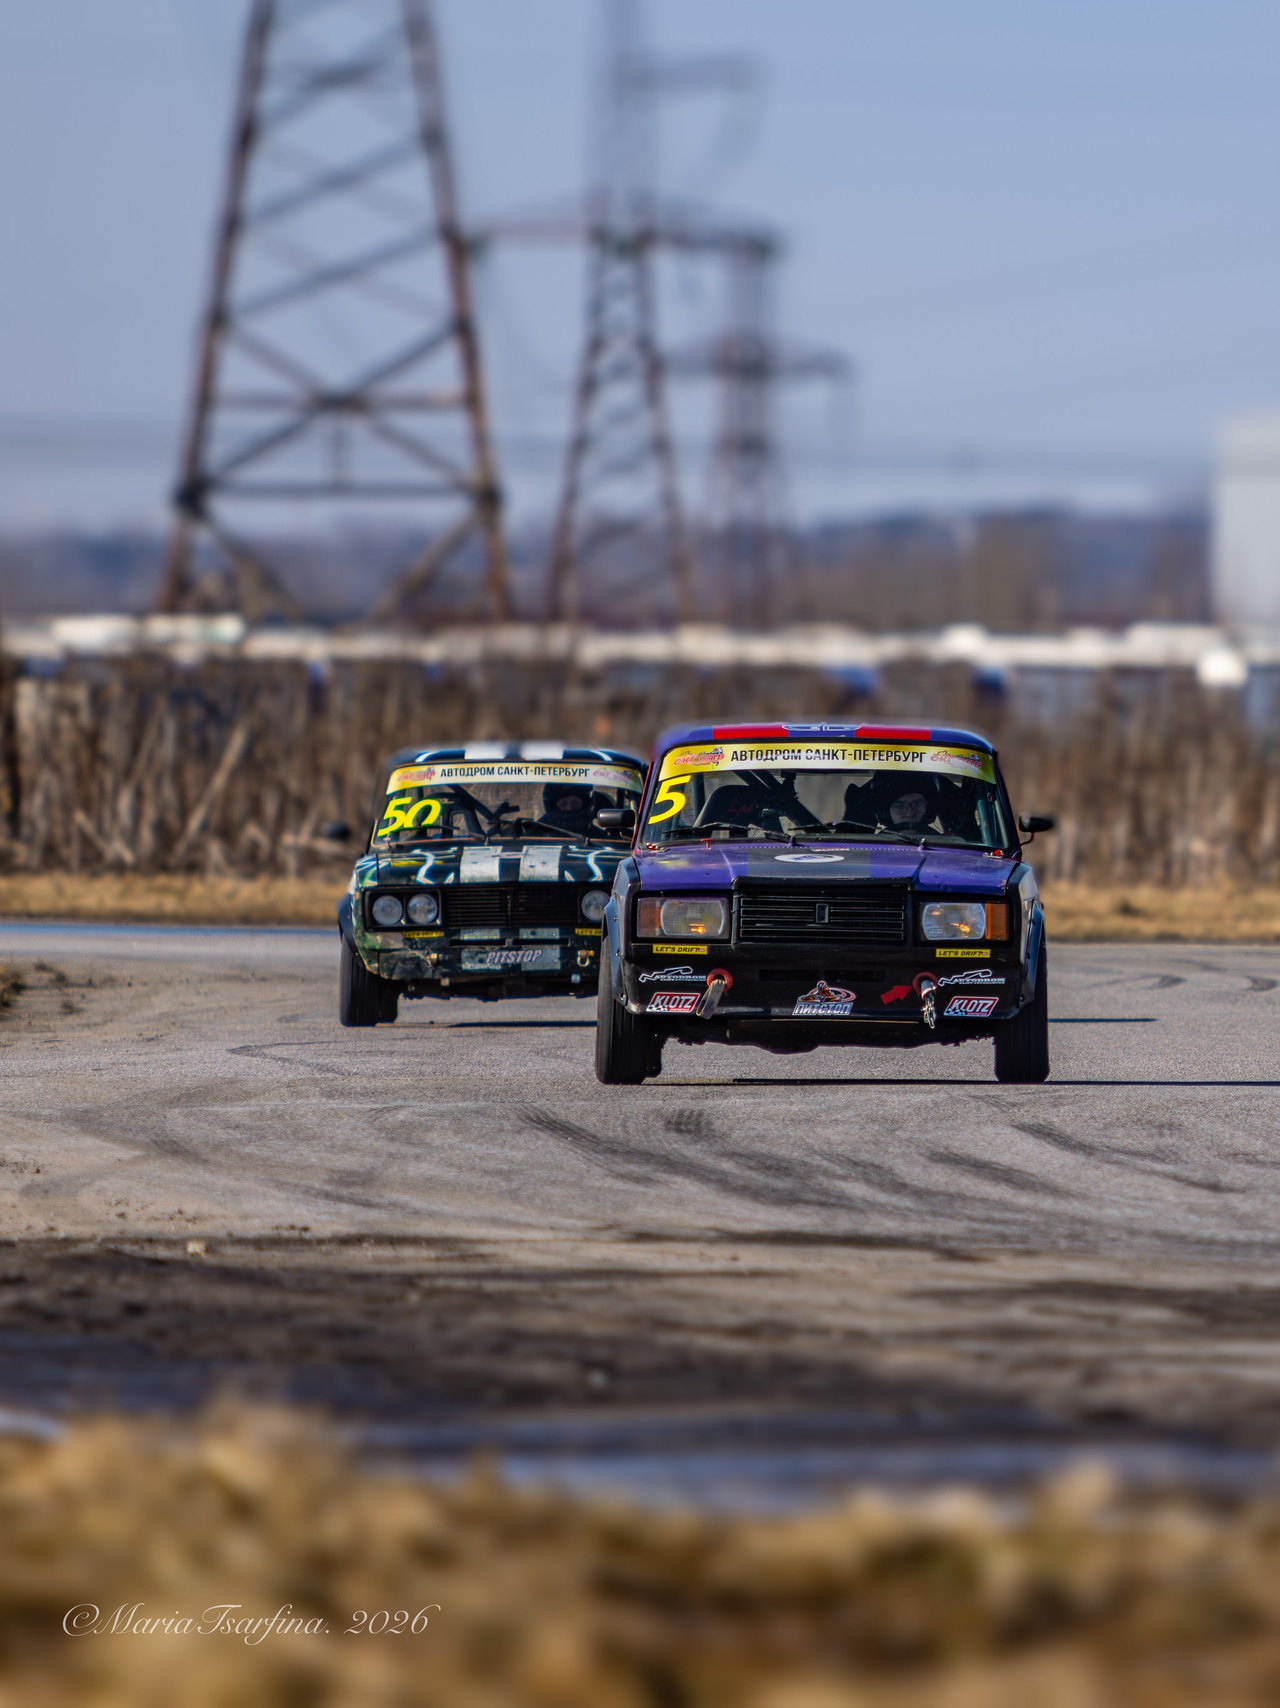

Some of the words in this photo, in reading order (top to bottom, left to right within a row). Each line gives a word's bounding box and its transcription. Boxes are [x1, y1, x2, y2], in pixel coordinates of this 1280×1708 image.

[730, 749, 802, 762] АВТОДРОМ
[805, 748, 927, 763] САНКТ-ПЕТЕРБУРГ
[440, 766, 495, 778] АВТОДРОМ
[497, 765, 591, 778] САНКТ-ПЕТЕРБУРГ
[648, 775, 692, 825] 5
[377, 796, 441, 837] 50
[485, 949, 542, 965] PITSTOP
[653, 995, 696, 1009] KLOTZ
[795, 1003, 851, 1014] ПИТСТОП
[950, 1000, 993, 1013] KLOTZ
